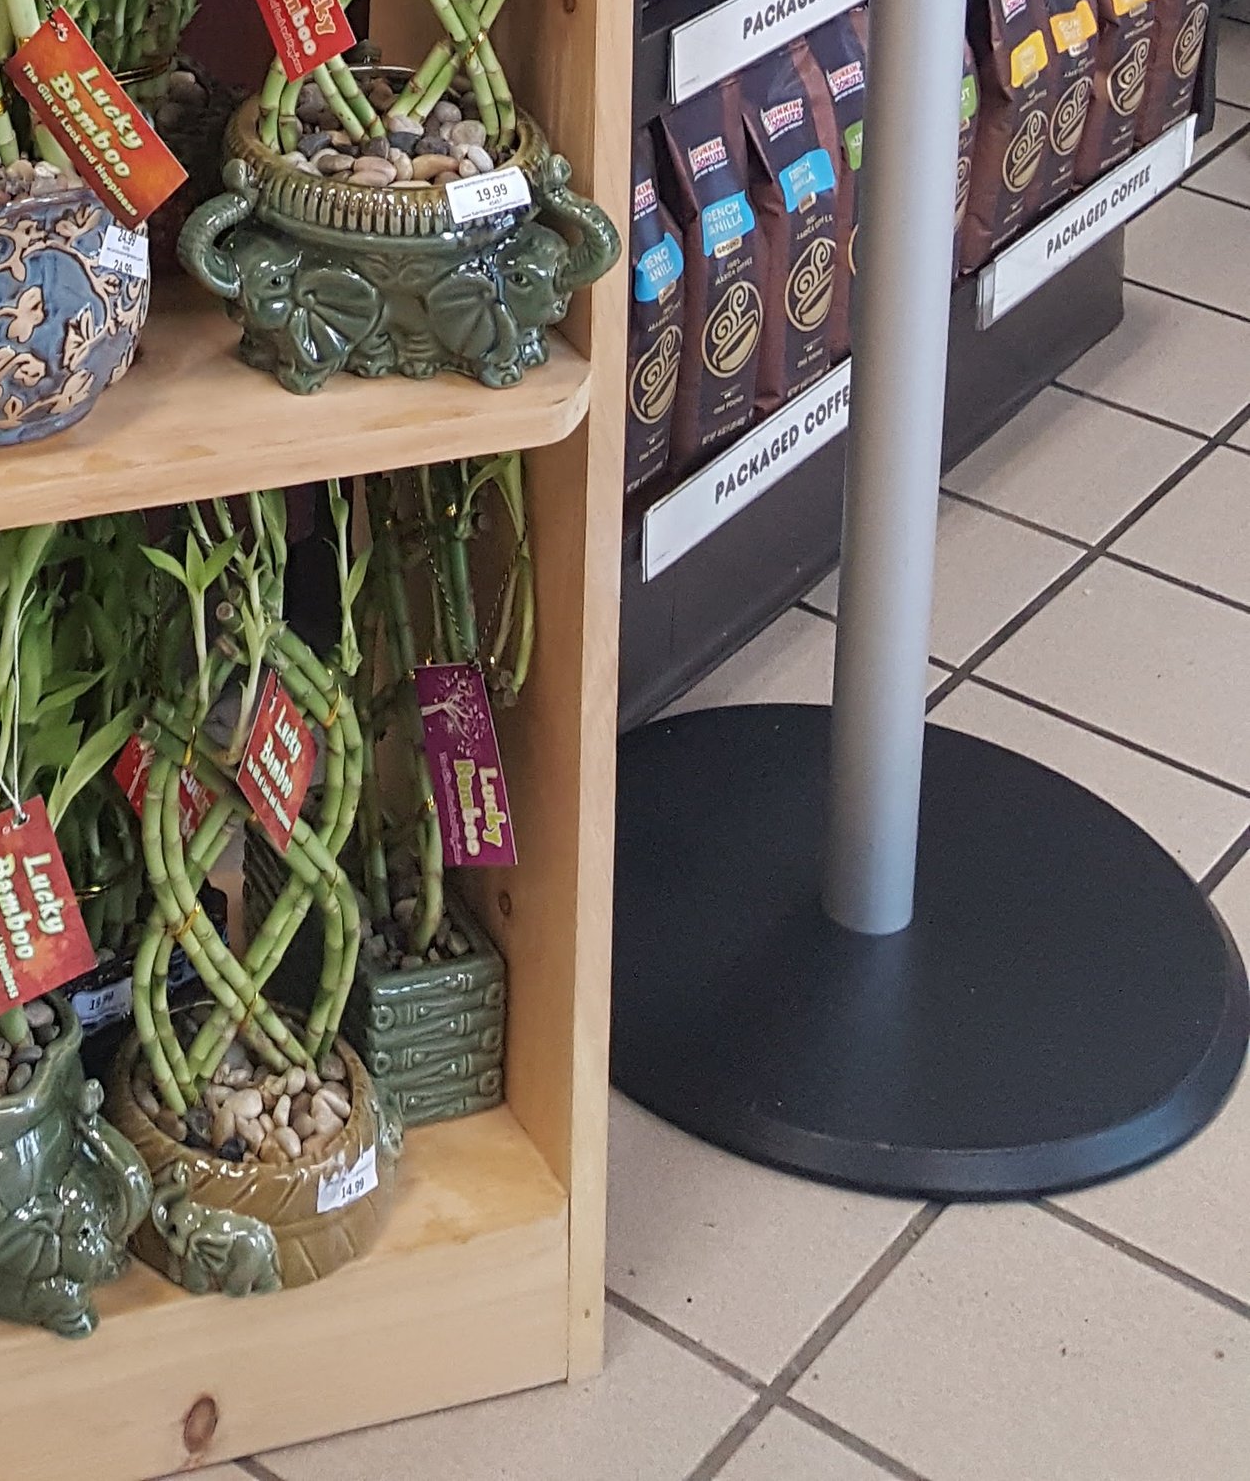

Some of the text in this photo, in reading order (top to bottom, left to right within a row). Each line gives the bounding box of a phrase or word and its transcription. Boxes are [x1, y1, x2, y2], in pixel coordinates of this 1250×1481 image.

[22, 63, 139, 216] The Gift of Luck and Happiness
[50, 70, 131, 178] Bamboo
[77, 66, 144, 150] Lucky
[772, 111, 803, 130] DONUTS
[476, 183, 508, 203] 19.99
[697, 149, 726, 168] DONUTS
[118, 229, 136, 246] 24.99
[1047, 164, 1151, 259] PACKAGED COFFEE
[715, 385, 850, 504] PACKAGED COFFE
[259, 731, 293, 800] Bamboo
[274, 704, 302, 764] Lucky
[454, 759, 482, 856] Bamboo
[479, 767, 507, 847] Lucky
[22, 852, 64, 934] Lucky
